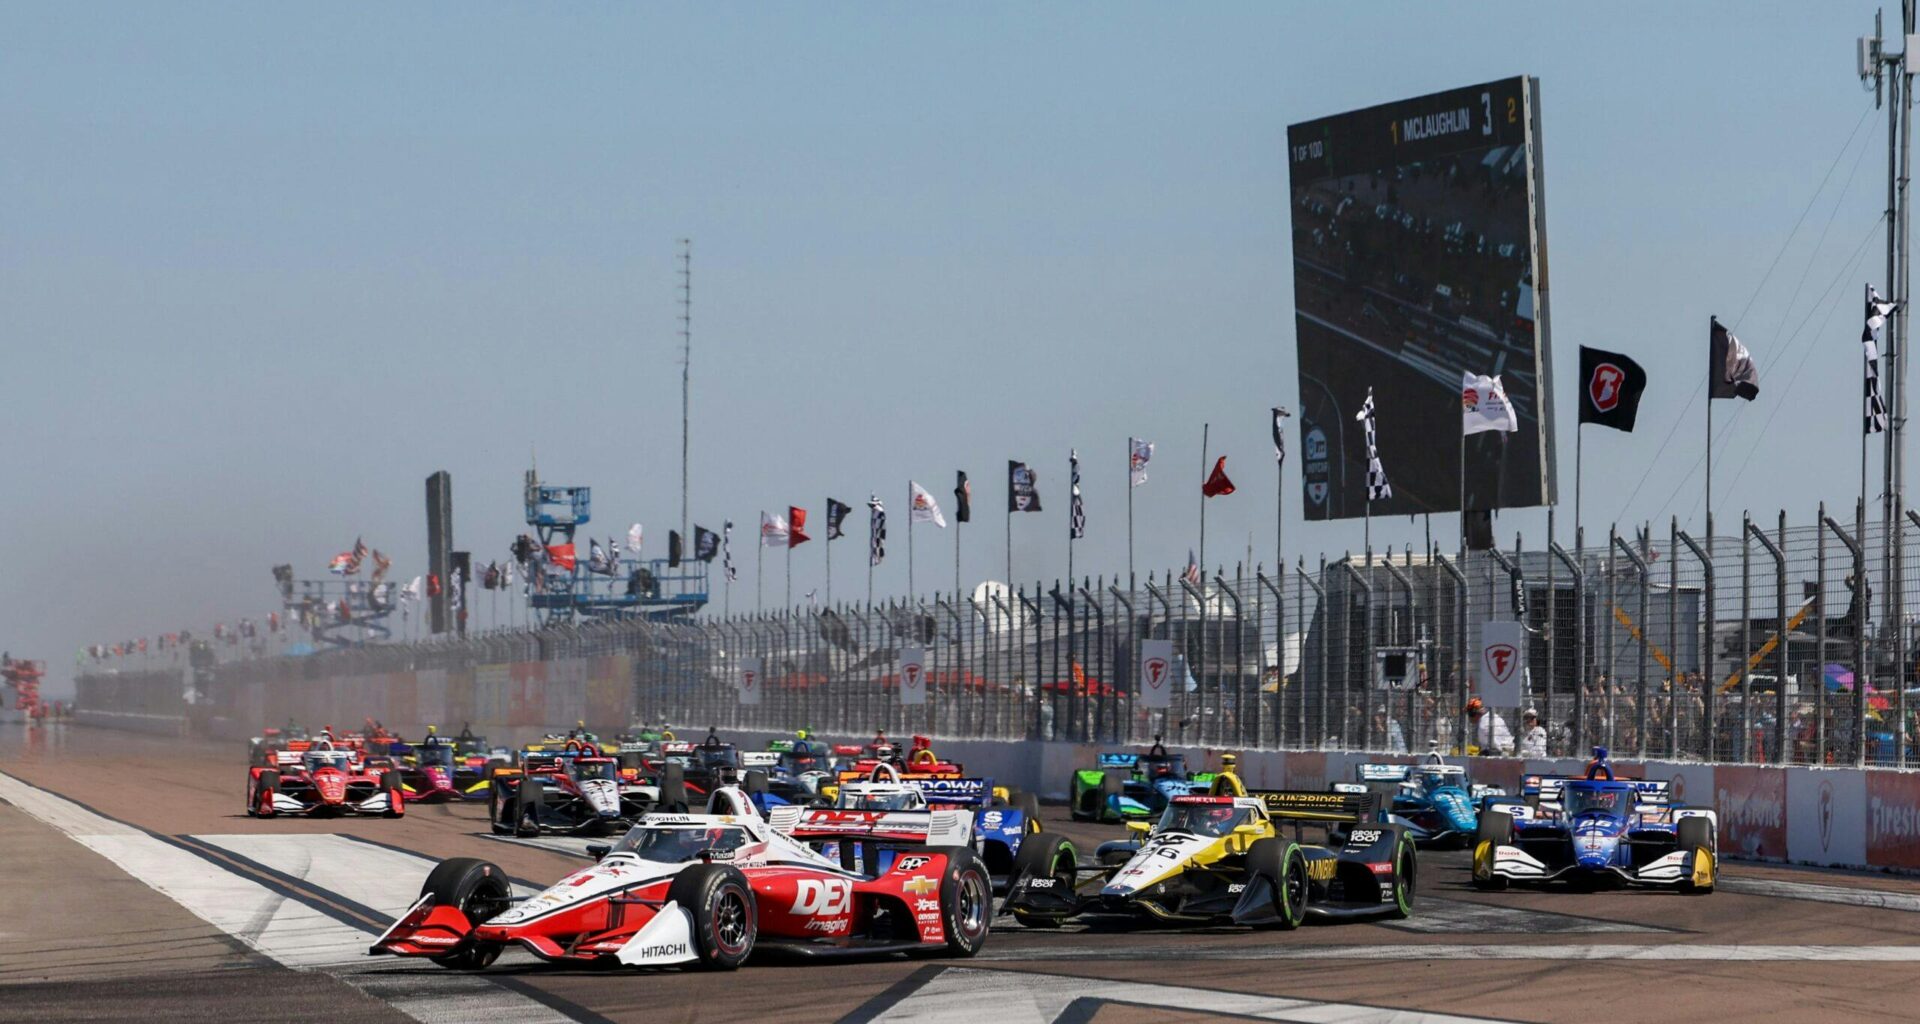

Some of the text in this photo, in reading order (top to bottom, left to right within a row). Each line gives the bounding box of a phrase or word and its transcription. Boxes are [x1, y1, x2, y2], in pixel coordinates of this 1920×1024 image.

[1481, 92, 1492, 136] 3
[1507, 97, 1517, 124] 2
[1391, 107, 1470, 145] 1 MCLAUGHLIN
[1293, 141, 1323, 162] 1 OF 100
[1268, 792, 1346, 803] GAINBRIDGE
[788, 878, 852, 916] DEX
[914, 898, 939, 912] XPEL
[804, 917, 849, 933] imaging
[642, 943, 686, 958] HITACHI
